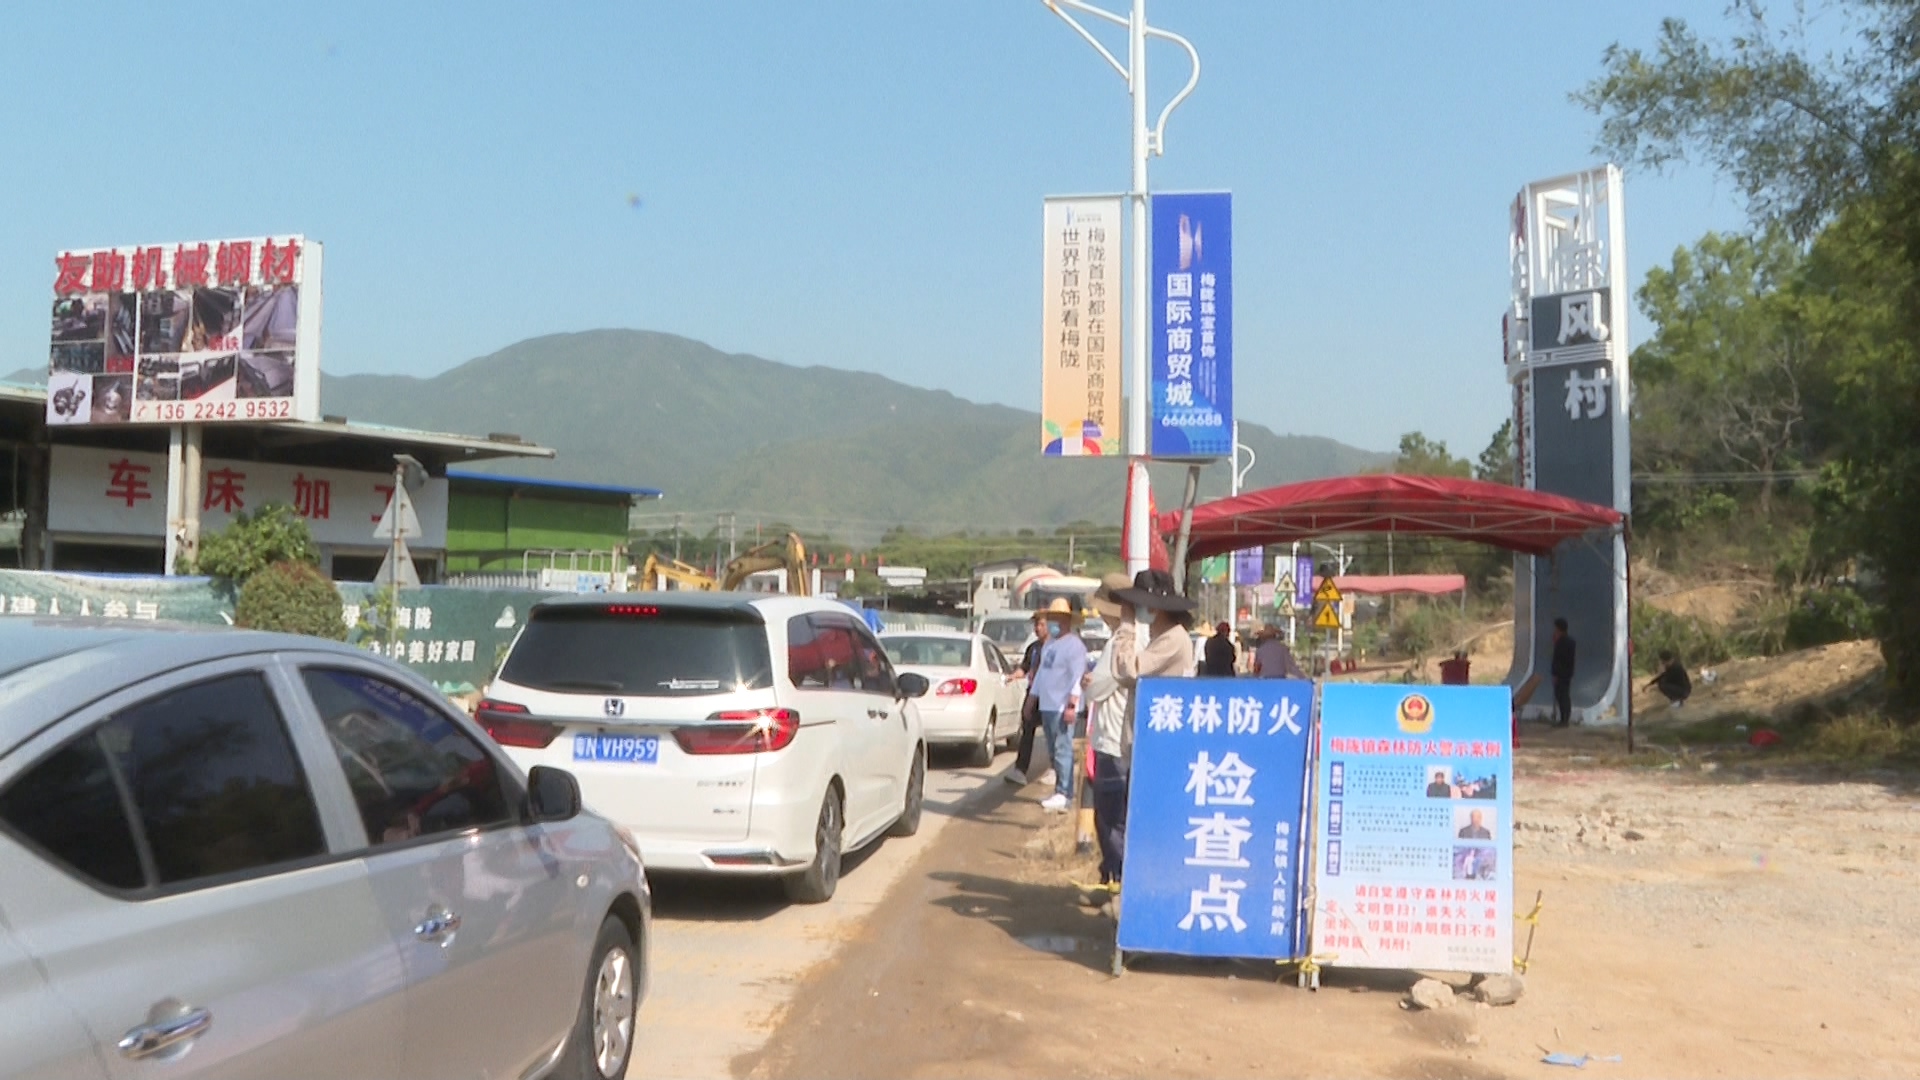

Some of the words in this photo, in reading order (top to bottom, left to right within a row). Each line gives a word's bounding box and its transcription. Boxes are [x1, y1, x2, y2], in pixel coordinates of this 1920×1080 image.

[53, 236, 300, 297] 友助机械钢材
[1060, 228, 1081, 368] 世界首饰看梅陇
[1087, 227, 1106, 428] 梅陇首饰都在国际商贸城
[1166, 273, 1194, 407] 国际商贸城
[1557, 292, 1611, 420] 风村
[155, 403, 185, 419] 136
[194, 402, 237, 418] 2242
[246, 400, 290, 418] 9532
[1148, 694, 1302, 736] 森林防火
[1330, 737, 1502, 758] 梅陇镇森林防火警示案例
[1177, 751, 1257, 933] 检查点
[1270, 821, 1290, 936] 梅陇镇人民政府
